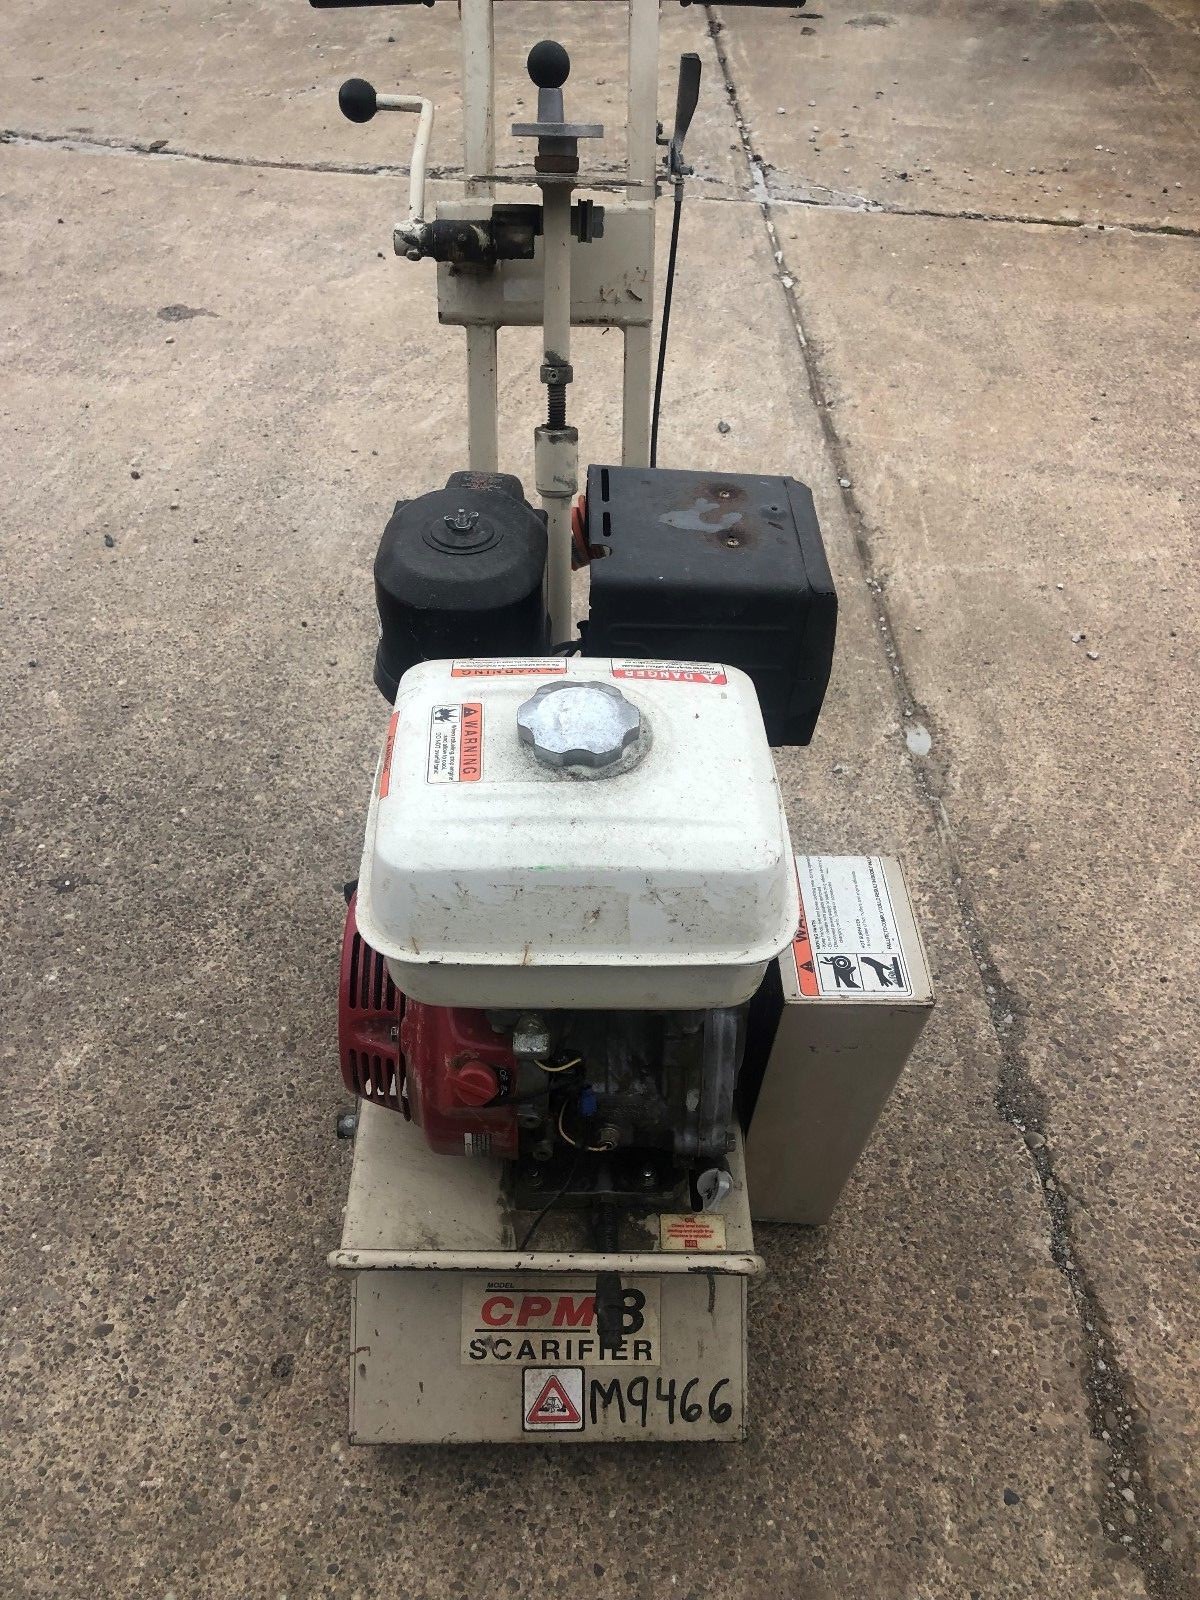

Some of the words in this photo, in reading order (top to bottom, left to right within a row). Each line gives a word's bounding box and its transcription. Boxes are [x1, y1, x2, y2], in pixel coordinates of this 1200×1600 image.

[462, 668, 540, 676] WARNING
[624, 669, 693, 680] DANGER
[463, 720, 479, 774] WARNING
[481, 1296, 597, 1327] CPM
[468, 1338, 653, 1361] SCARIFIER
[590, 1376, 733, 1427] M9466
